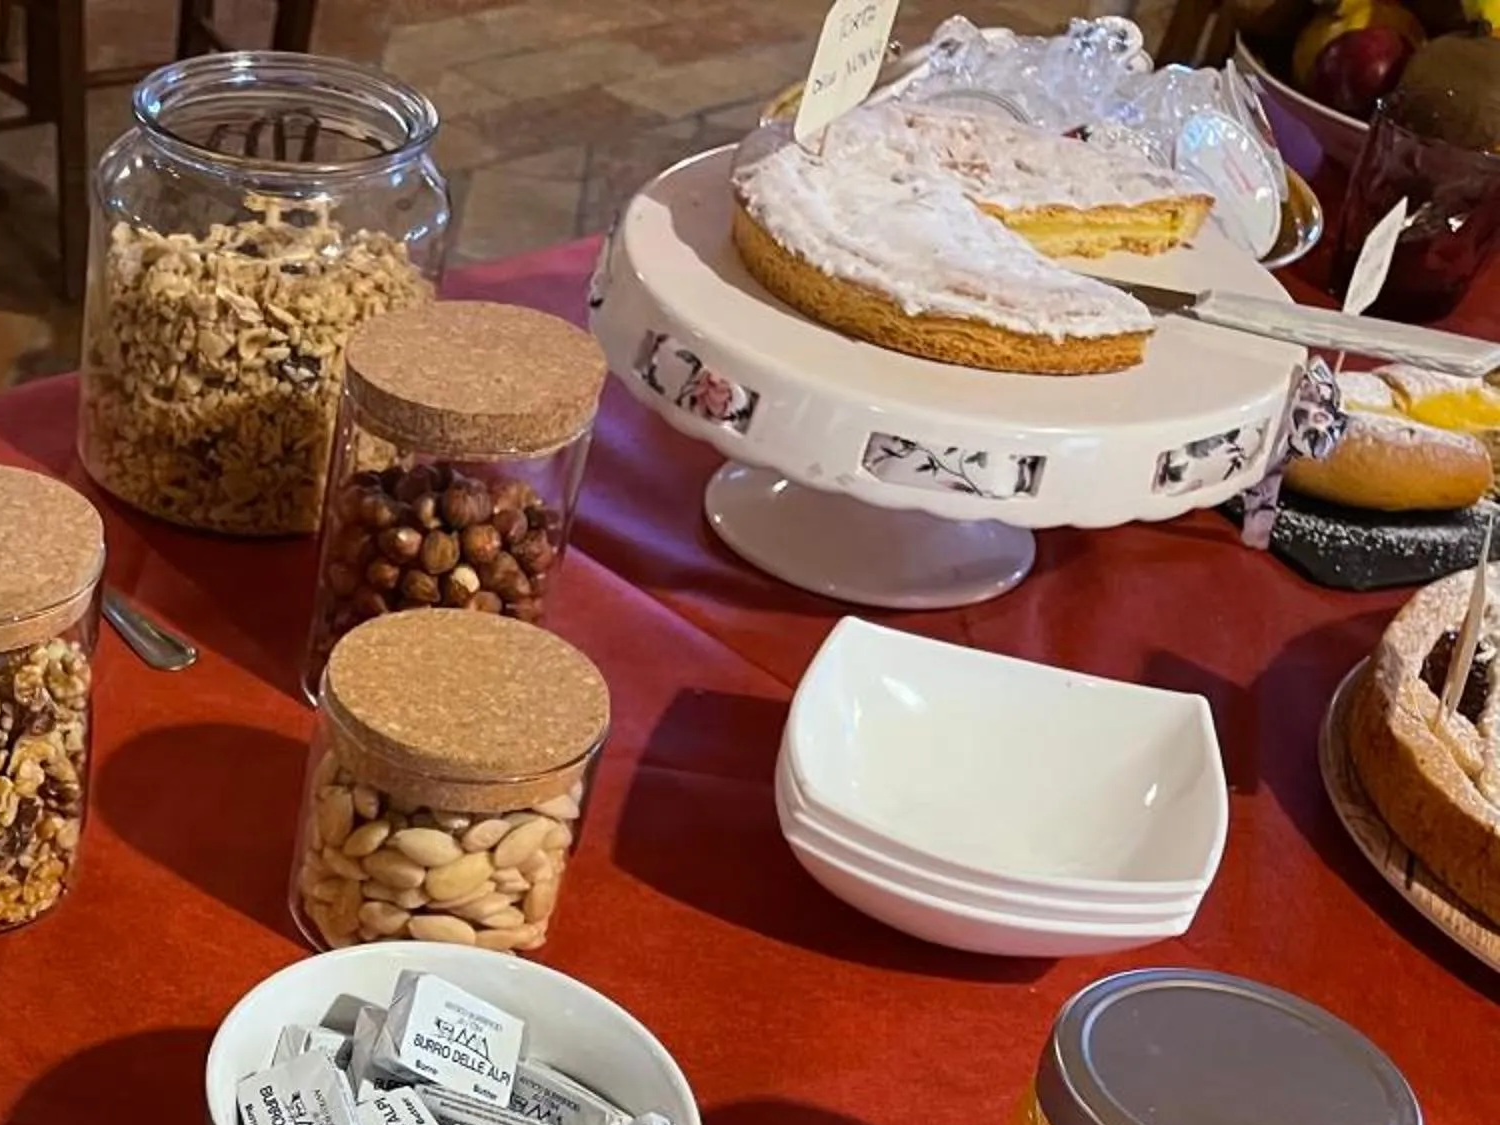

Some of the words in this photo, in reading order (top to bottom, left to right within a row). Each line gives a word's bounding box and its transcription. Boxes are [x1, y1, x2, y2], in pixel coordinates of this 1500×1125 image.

[411, 1032, 452, 1058] BURRO
[450, 1049, 488, 1074] DELLE
[486, 1066, 512, 1086] ALPI
